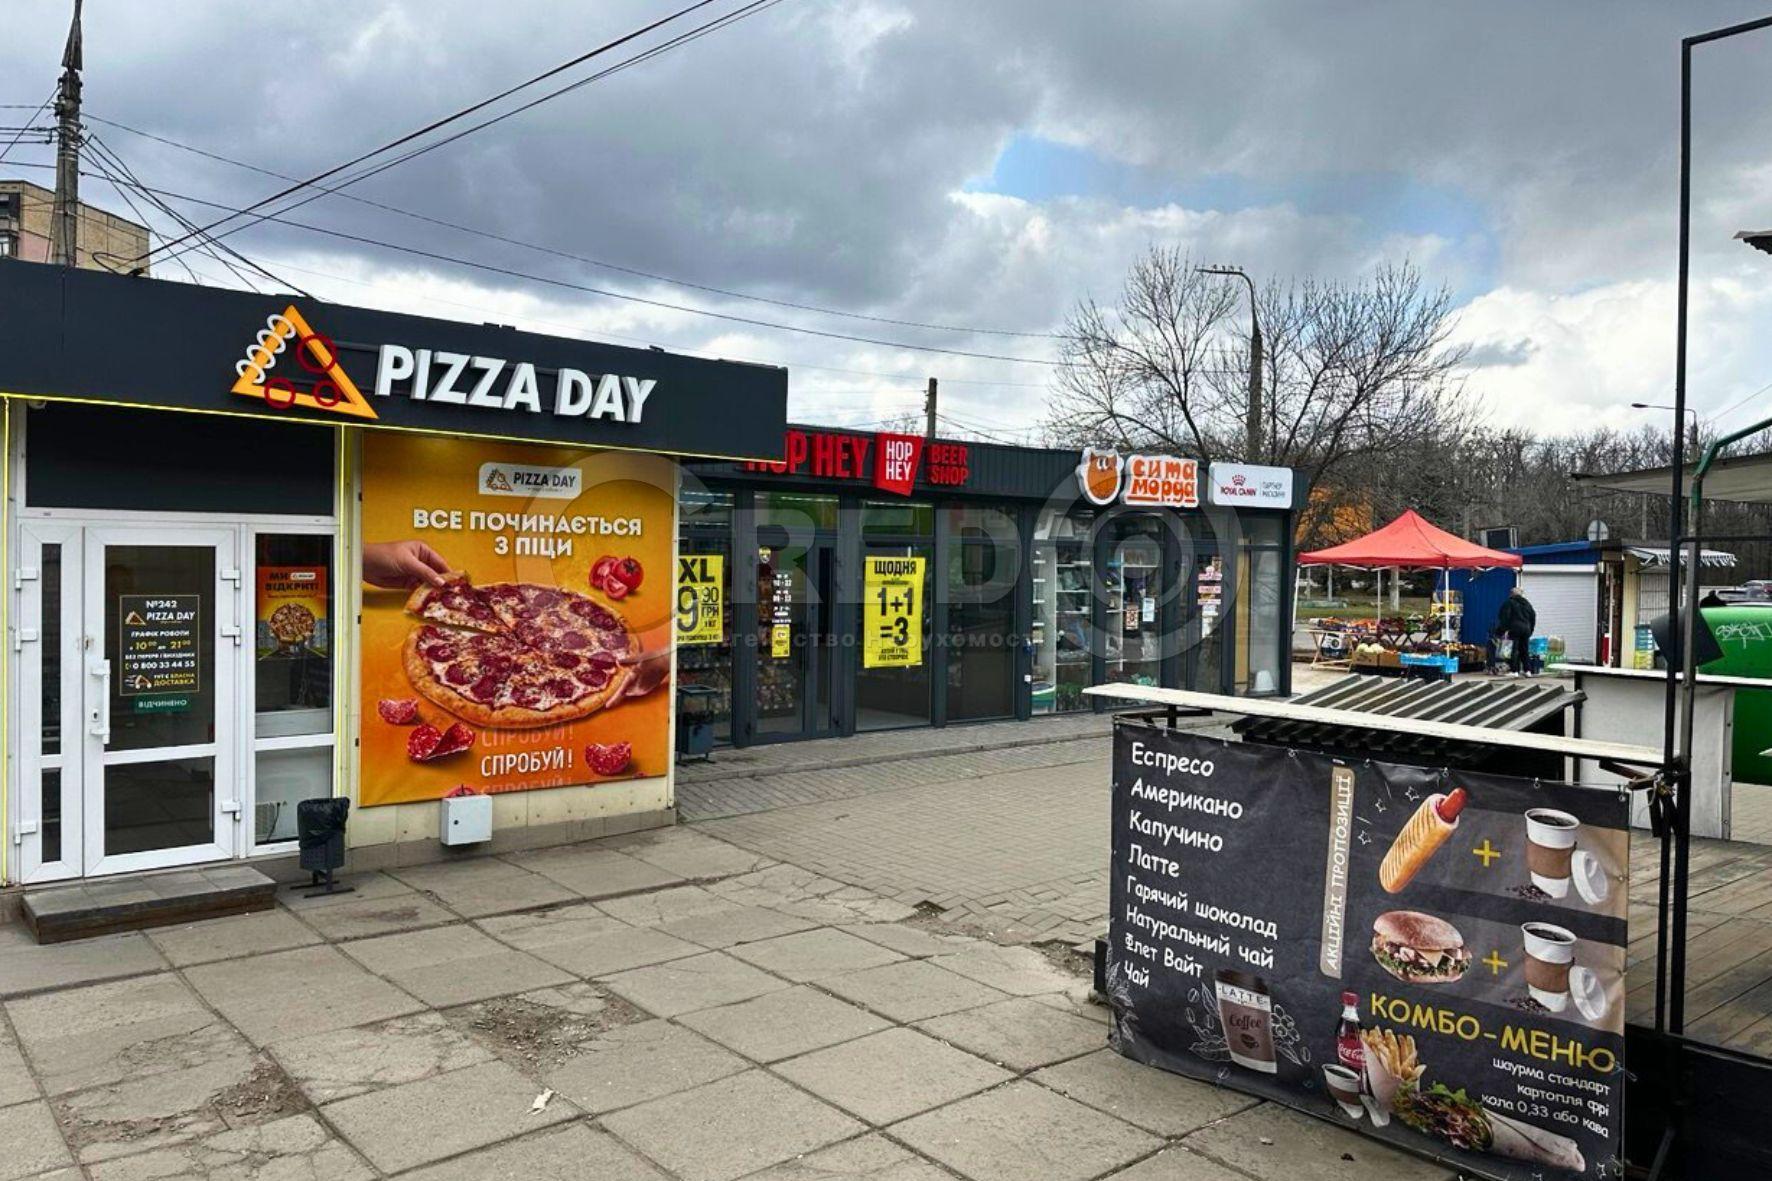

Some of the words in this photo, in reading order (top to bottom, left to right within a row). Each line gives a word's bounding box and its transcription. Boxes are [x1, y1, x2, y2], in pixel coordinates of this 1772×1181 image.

[375, 344, 541, 414] PIZZA
[553, 367, 657, 423] DAY
[812, 433, 869, 479] HEY
[886, 440, 913, 461] HOP
[929, 444, 967, 465] BEER
[513, 471, 549, 486] PIZZA
[552, 474, 576, 488] DAY
[886, 461, 911, 481] HEY
[929, 466, 969, 485] SHOP
[413, 509, 463, 531] ВСЕ
[470, 512, 643, 537] ПОЧИНАЄТЬСЯ
[515, 537, 572, 559] ПІЦИ
[678, 558, 715, 583] XL
[874, 560, 917, 576] ЩОДНЯ
[146, 611, 174, 621] PIZZA
[176, 611, 195, 620] DAY
[677, 585, 699, 632] 9
[702, 586, 720, 603] 90
[701, 606, 720, 618] ГРН
[877, 587, 913, 617] 1+1
[159, 661, 171, 669] 33
[171, 660, 183, 668] 44
[184, 660, 196, 668] 55
[153, 679, 195, 687] ДОСТАВКА
[138, 700, 187, 709] ВІДЧИНЕНО
[1131, 742, 1214, 777] Еспресо
[1131, 778, 1243, 819] Американо
[1129, 810, 1223, 852] Капучино
[1330, 776, 1352, 889] ПРОПОЗИЦІЇ
[1128, 844, 1180, 878] Латте
[1127, 875, 1188, 912] Гарячий
[1195, 901, 1278, 940] шоколад
[1126, 904, 1230, 956] Натуральний
[1238, 945, 1274, 969] чай
[1325, 895, 1343, 970] АКЦІЙНІ
[1124, 961, 1150, 988] Чай
[1164, 947, 1203, 979] Вайт
[1221, 988, 1265, 1004] LATTE
[1229, 1013, 1262, 1031] Coffee
[1493, 1057, 1544, 1081] шаурма
[1548, 1072, 1610, 1096] стандарт
[1517, 1084, 1583, 1108] картопля
[1587, 1098, 1610, 1117] фрі
[1482, 1094, 1514, 1111] кола
[1517, 1100, 1549, 1118] 0,33
[1553, 1105, 1578, 1124] або
[1582, 1117, 1609, 1138] кава
